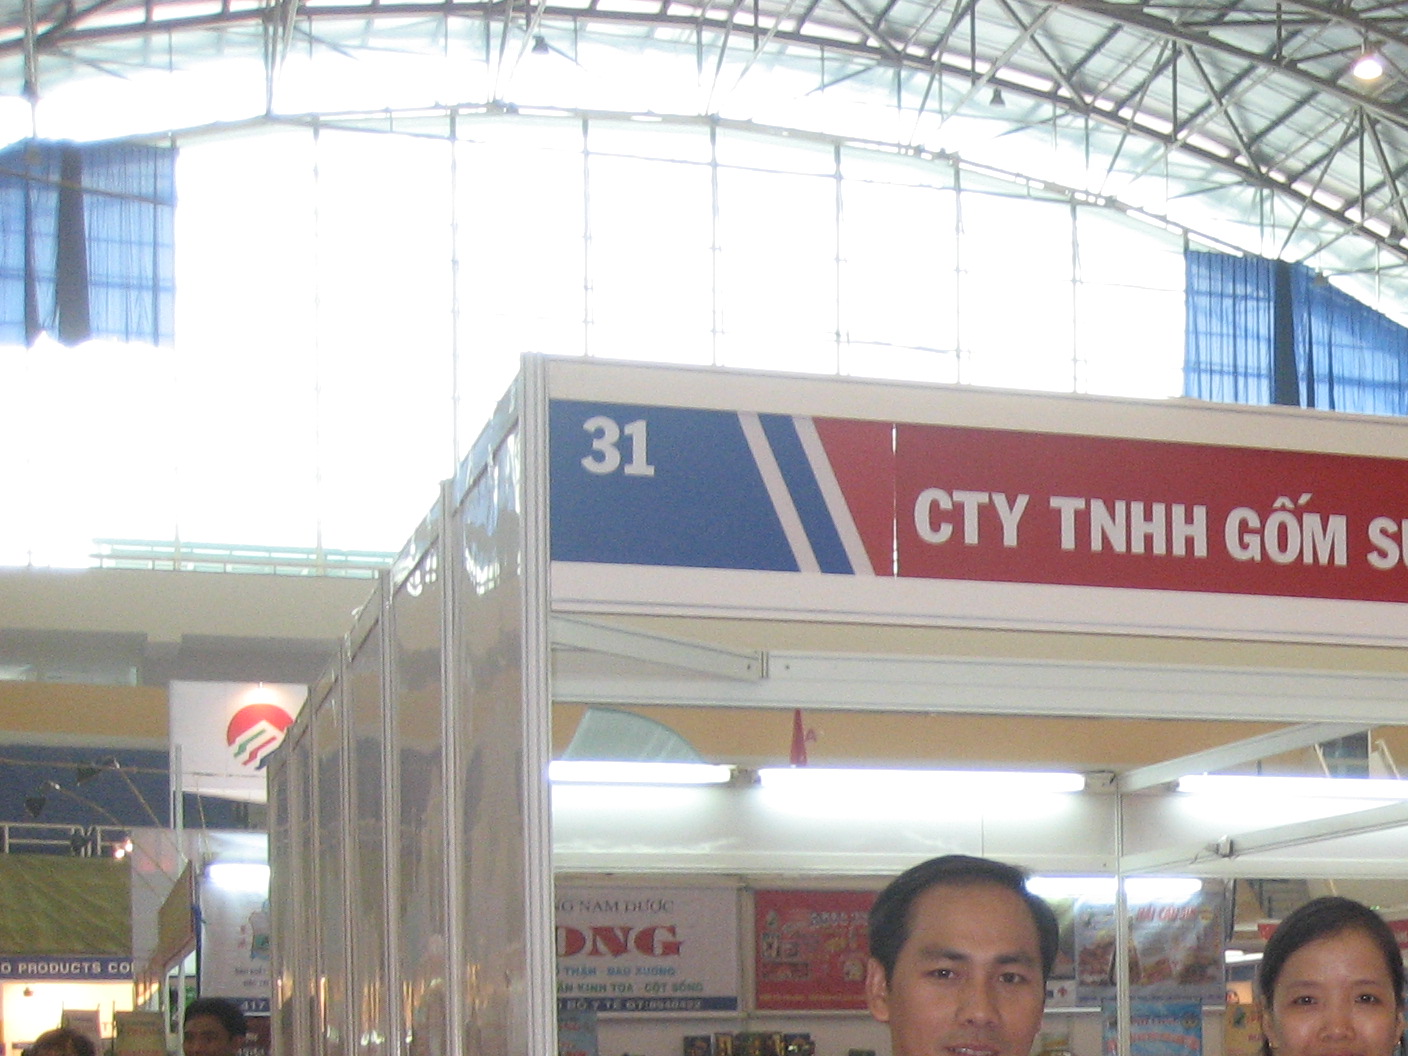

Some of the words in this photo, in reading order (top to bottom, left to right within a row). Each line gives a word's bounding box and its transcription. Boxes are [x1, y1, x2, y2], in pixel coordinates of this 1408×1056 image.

[581, 415, 655, 477] 31
[914, 487, 1030, 548] CTY
[1050, 495, 1208, 559] TNHH
[1224, 493, 1348, 567] GỐM
[19, 962, 100, 974] PRODUCTS
[108, 962, 133, 974] CO
